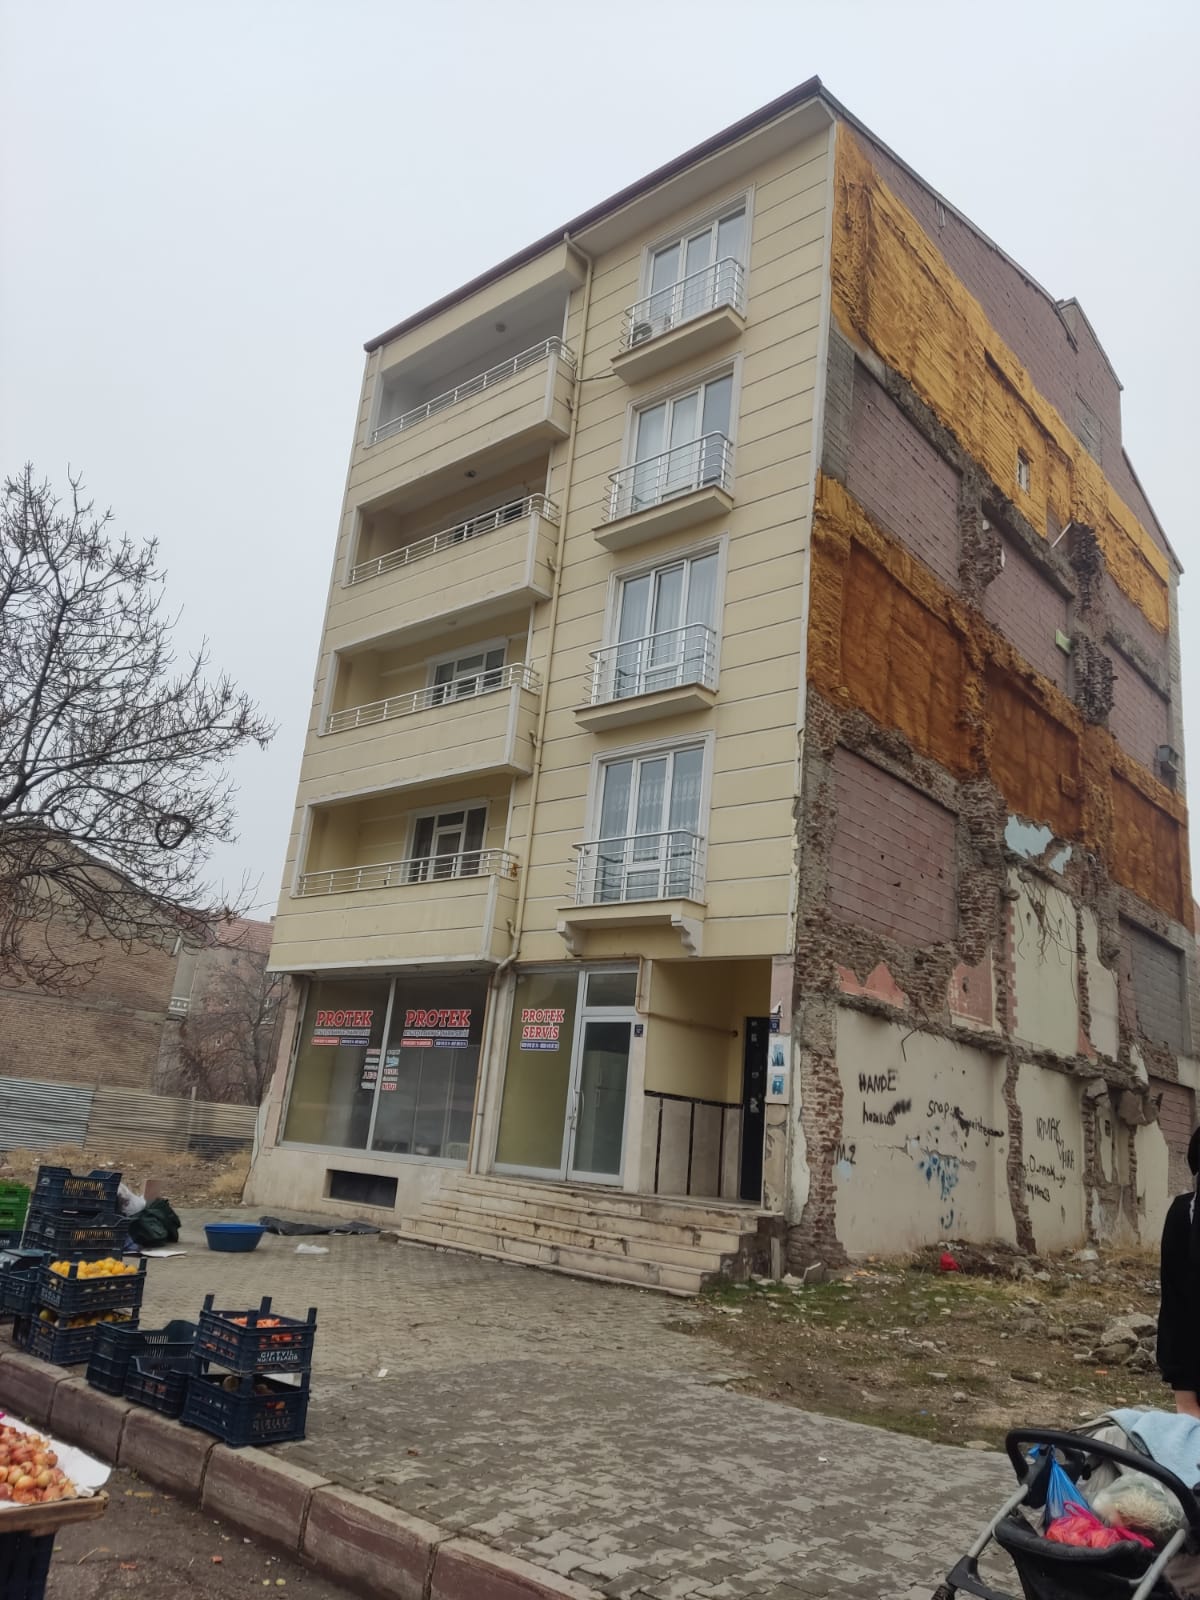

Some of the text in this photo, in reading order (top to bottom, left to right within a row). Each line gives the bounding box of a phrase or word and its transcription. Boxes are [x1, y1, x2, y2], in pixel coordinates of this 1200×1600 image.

[315, 1010, 374, 1027] PROTEK
[404, 1009, 472, 1027] PROTEK
[521, 1008, 565, 1023] PROTEK
[522, 1022, 560, 1040] SERVİS
[858, 1068, 897, 1095] HANDE
